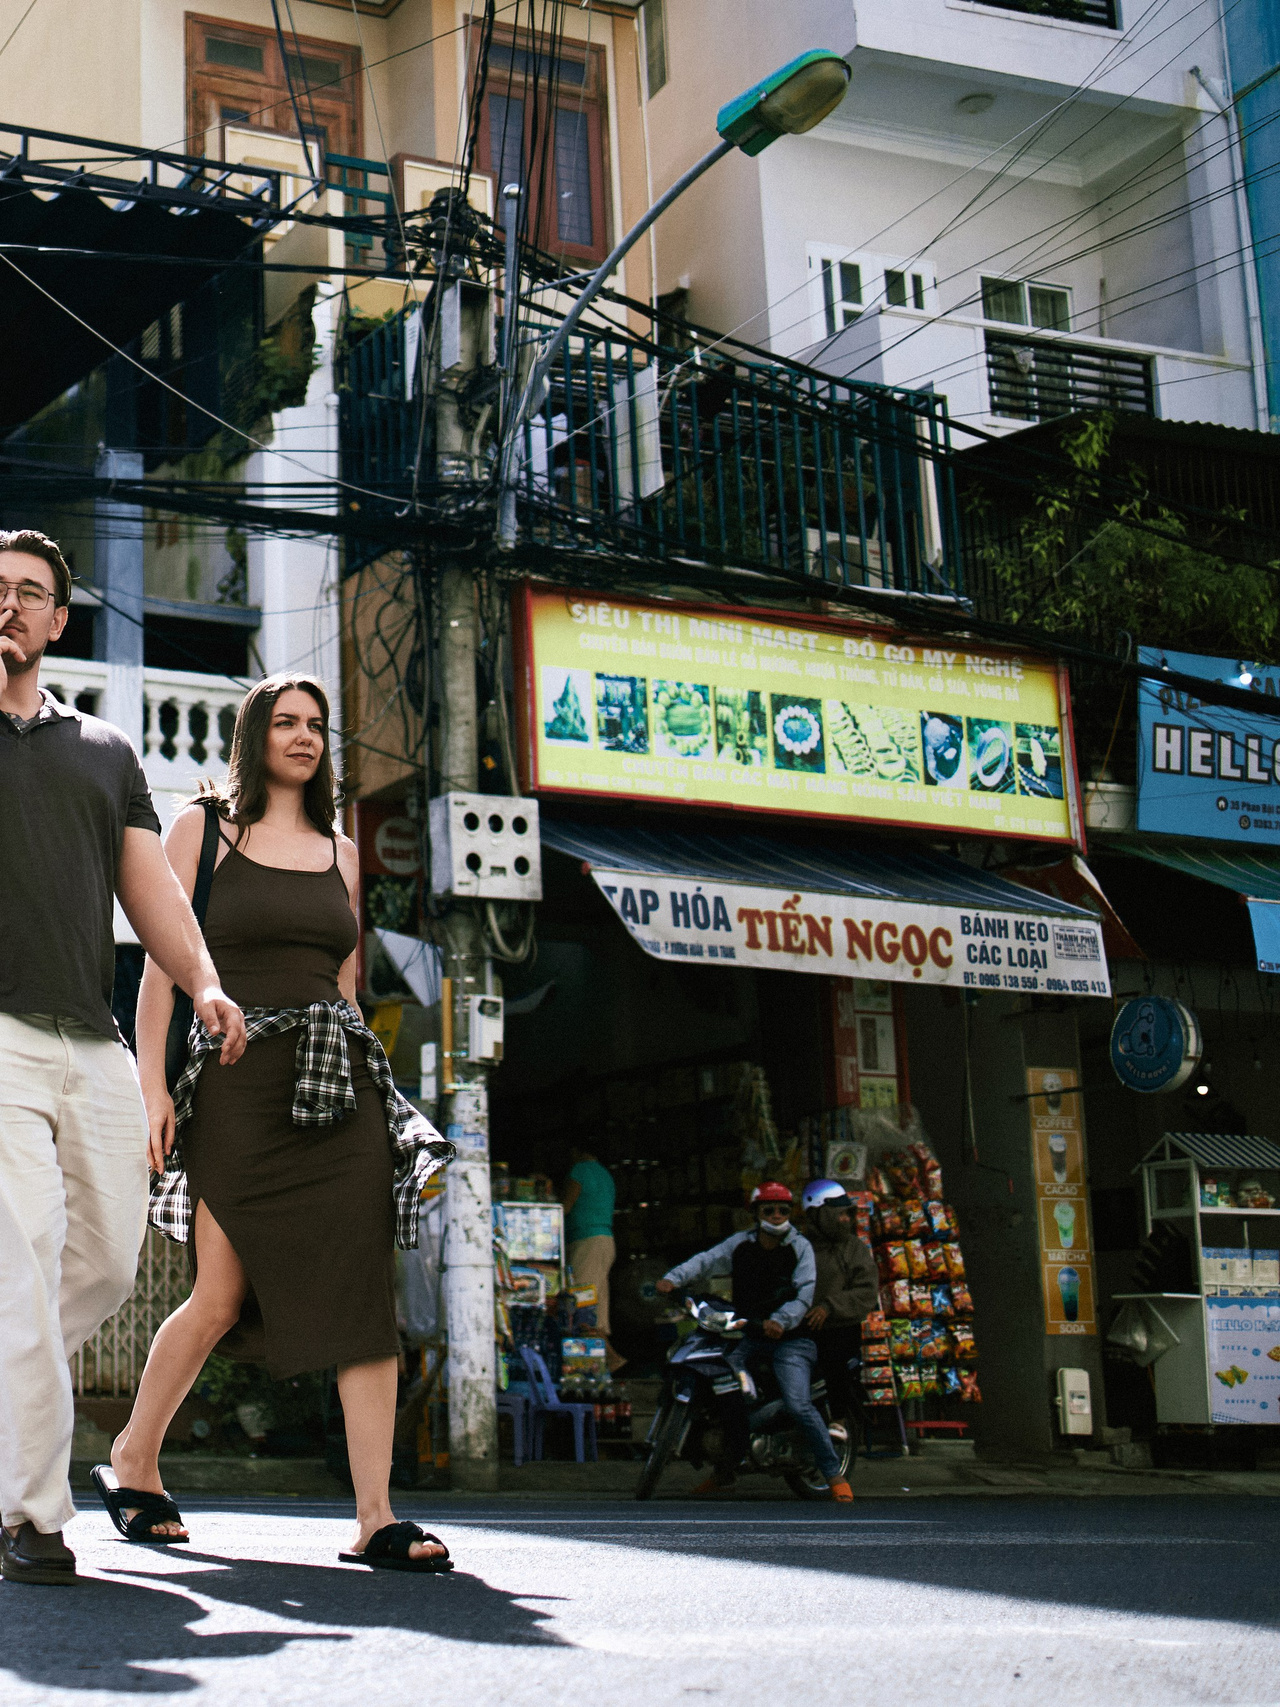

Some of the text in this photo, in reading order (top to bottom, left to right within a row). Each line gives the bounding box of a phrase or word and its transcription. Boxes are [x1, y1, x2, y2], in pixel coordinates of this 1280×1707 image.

[571, 602, 630, 630] SIÊU
[638, 612, 681, 640] THỊ
[690, 618, 743, 644] MINI
[751, 626, 819, 653] MART
[670, 887, 732, 933] HÓA
[737, 894, 953, 978] TIẾN NGỌC
[960, 912, 1049, 946] BÁNH KẸO
[966, 940, 1002, 966] CÁC
[1007, 947, 1048, 973] LOẠI
[1036, 1117, 1074, 1129] COFFEE
[1044, 1184, 1078, 1195] CACAO
[1048, 1251, 1087, 1262] MATCHA
[1060, 1323, 1086, 1334] SODA
